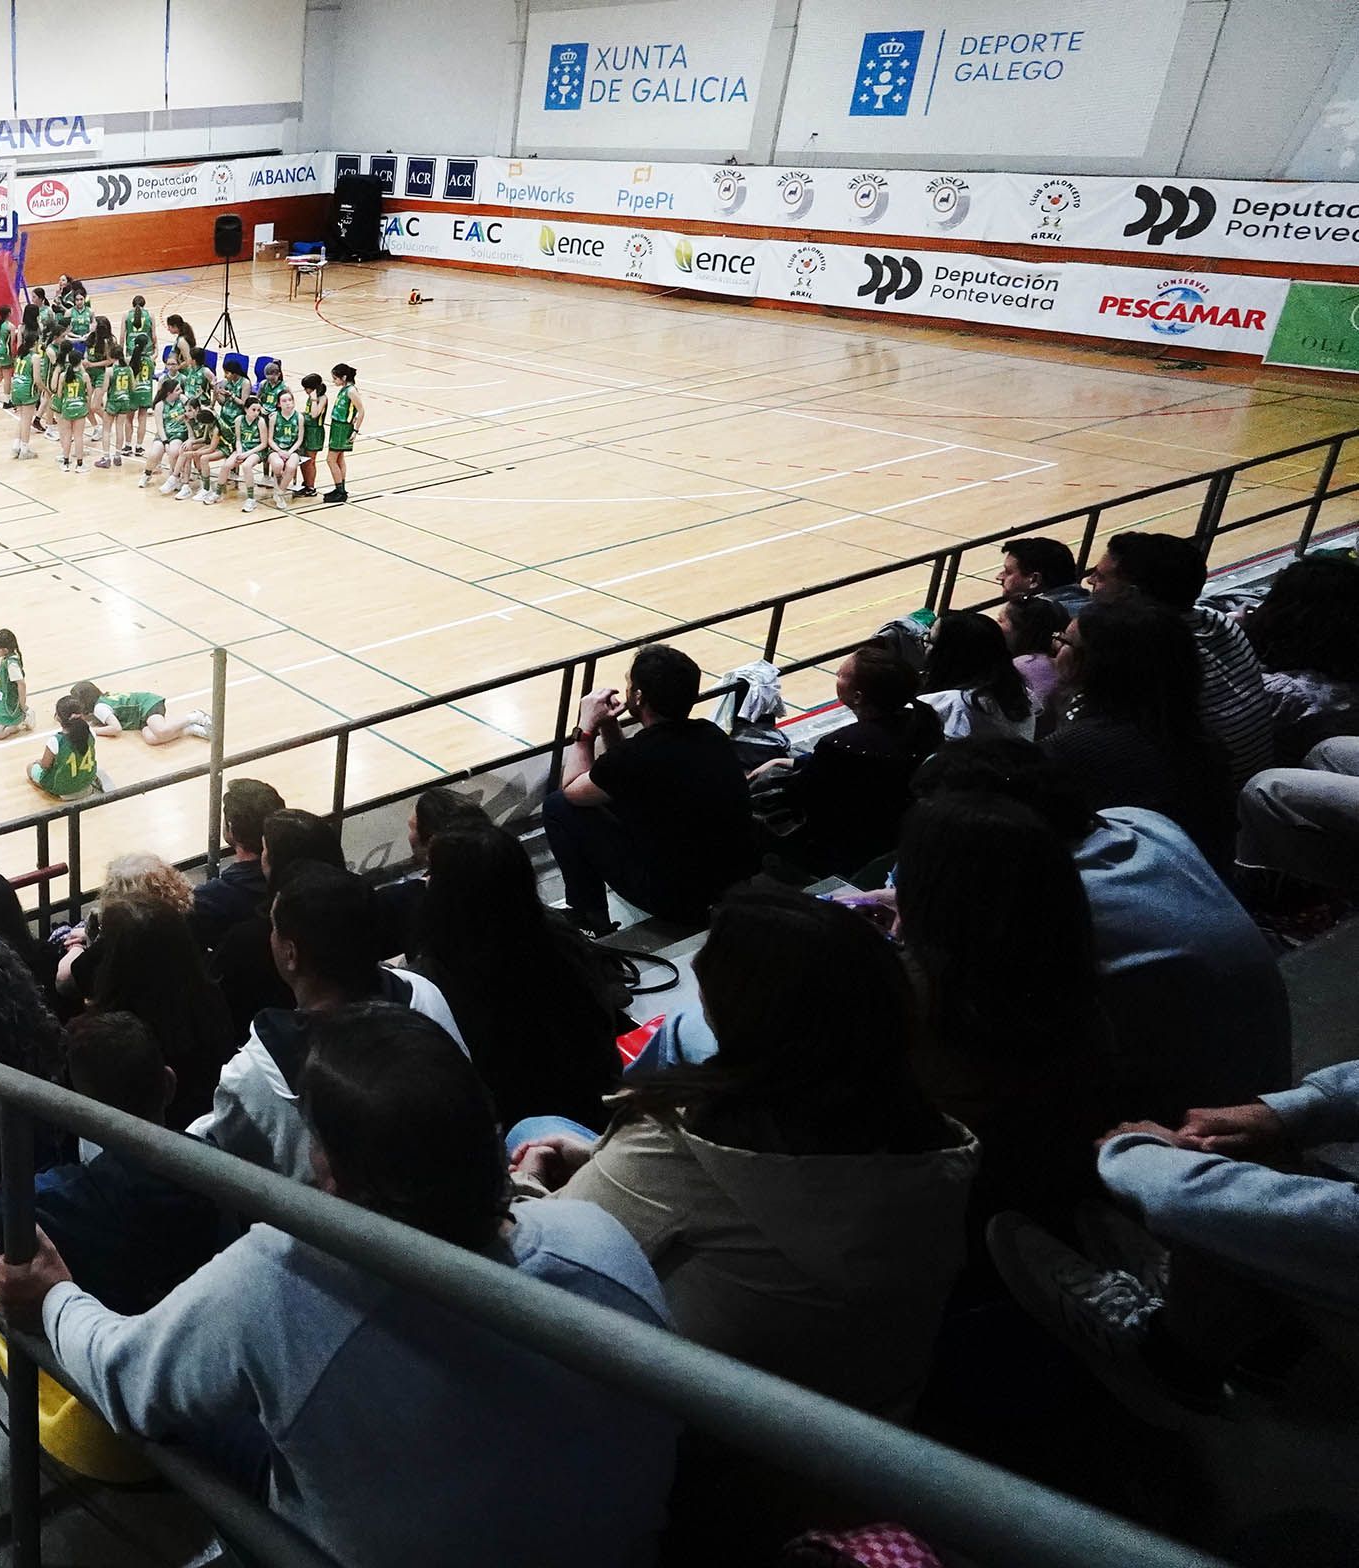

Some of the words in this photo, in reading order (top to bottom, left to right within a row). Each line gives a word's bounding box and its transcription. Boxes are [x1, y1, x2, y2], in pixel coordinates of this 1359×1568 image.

[960, 31, 1086, 55] DEPORTE
[595, 43, 688, 71] XUNTA
[954, 59, 1065, 82] GALEGO
[590, 79, 624, 104] DE
[633, 76, 748, 104] GALICIA
[137, 172, 198, 189] Deputación
[253, 165, 316, 186] ABANCA
[409, 171, 432, 185] ACR
[448, 173, 472, 187] ACR
[777, 170, 815, 189] SEISOL
[847, 173, 890, 192] SEISOL
[925, 176, 971, 195] SEISOL
[137, 187, 198, 201] Pontevedra
[496, 181, 575, 204] PipeWorks
[617, 189, 675, 213] PipePt
[31, 199, 65, 209] MAFARI
[453, 220, 503, 243] EAC
[1031, 231, 1062, 242] ARXIL
[471, 246, 524, 262] Soluciones
[557, 236, 605, 258] ence
[696, 252, 756, 275] ence
[934, 266, 1059, 292] Deputación
[1156, 277, 1211, 295] CONSERVAS
[929, 284, 1055, 311] Pontevedra
[1098, 295, 1267, 331] PESCAMAR
[66, 744, 95, 778] 14
